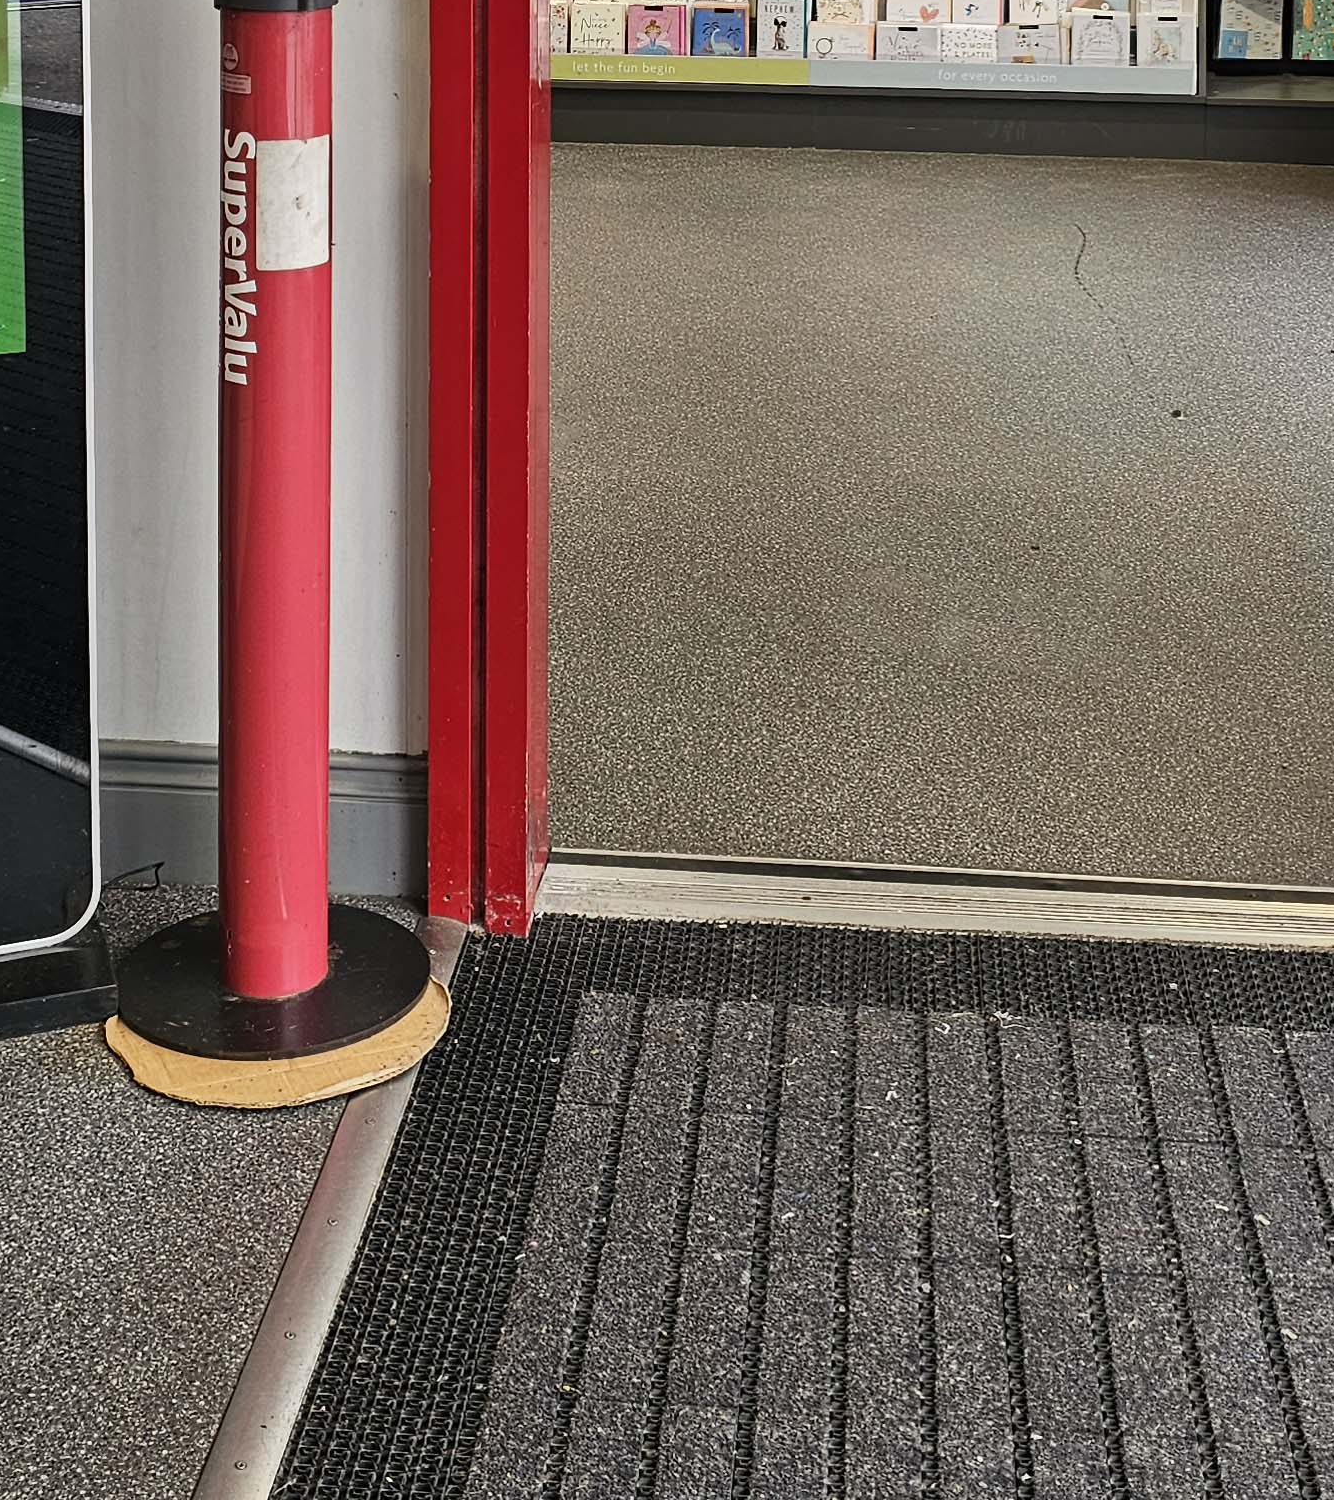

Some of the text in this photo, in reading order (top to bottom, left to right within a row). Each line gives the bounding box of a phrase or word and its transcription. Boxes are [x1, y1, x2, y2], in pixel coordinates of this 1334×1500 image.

[573, 61, 676, 77] let the fun begin
[938, 69, 1057, 85] for every occasion
[222, 128, 257, 386] SuperValu
